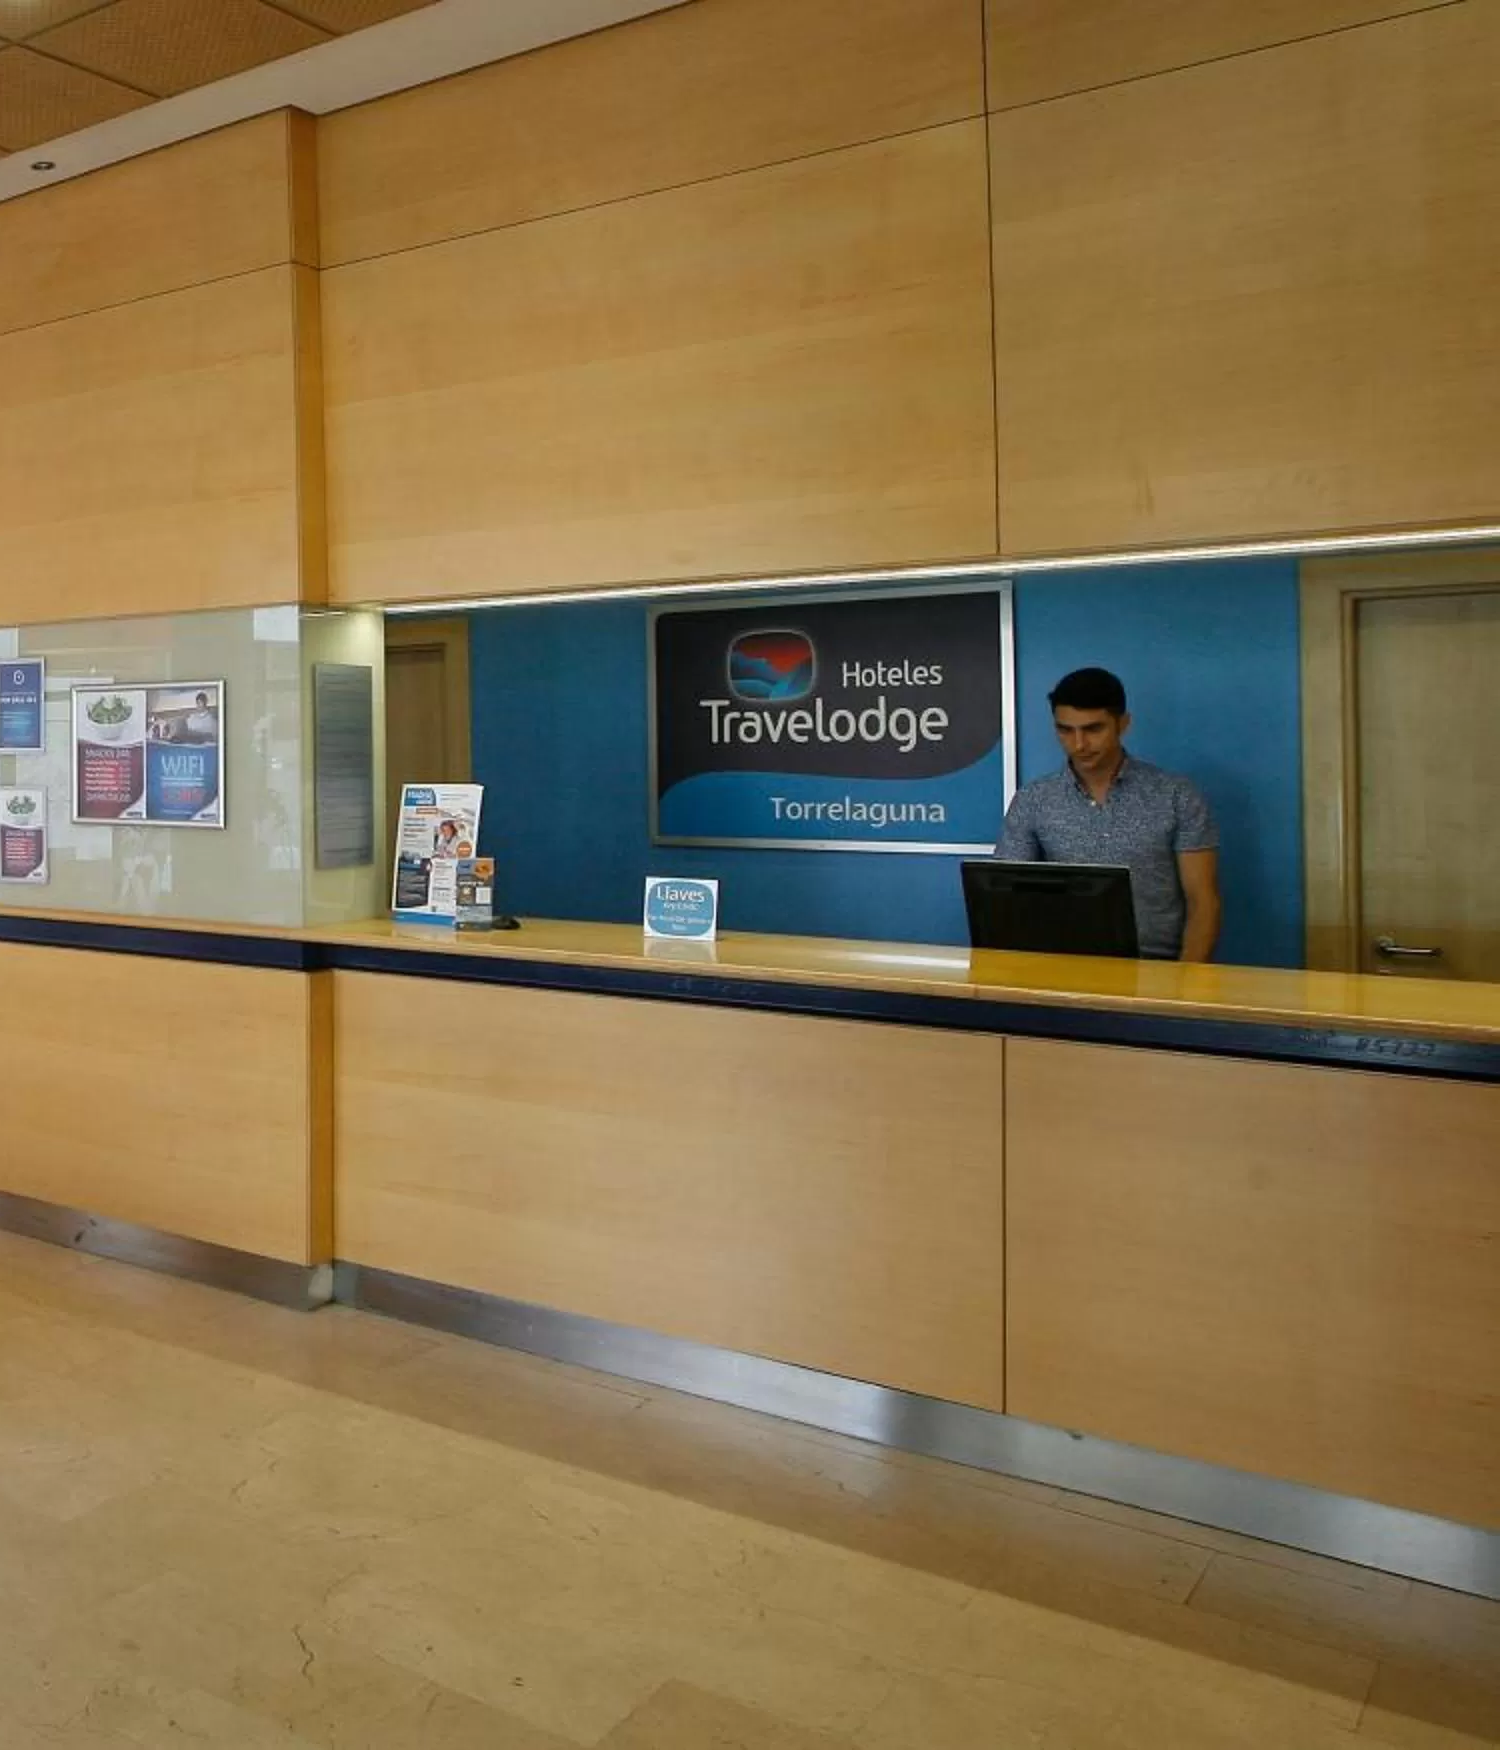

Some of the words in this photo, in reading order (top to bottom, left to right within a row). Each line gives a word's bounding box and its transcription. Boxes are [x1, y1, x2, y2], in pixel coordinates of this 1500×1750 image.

[842, 659, 943, 688] Hoteles
[700, 696, 949, 753] Travelodge
[161, 754, 205, 777] WIFI
[770, 796, 946, 827] Torrelaguna
[656, 885, 705, 903] Llaves
